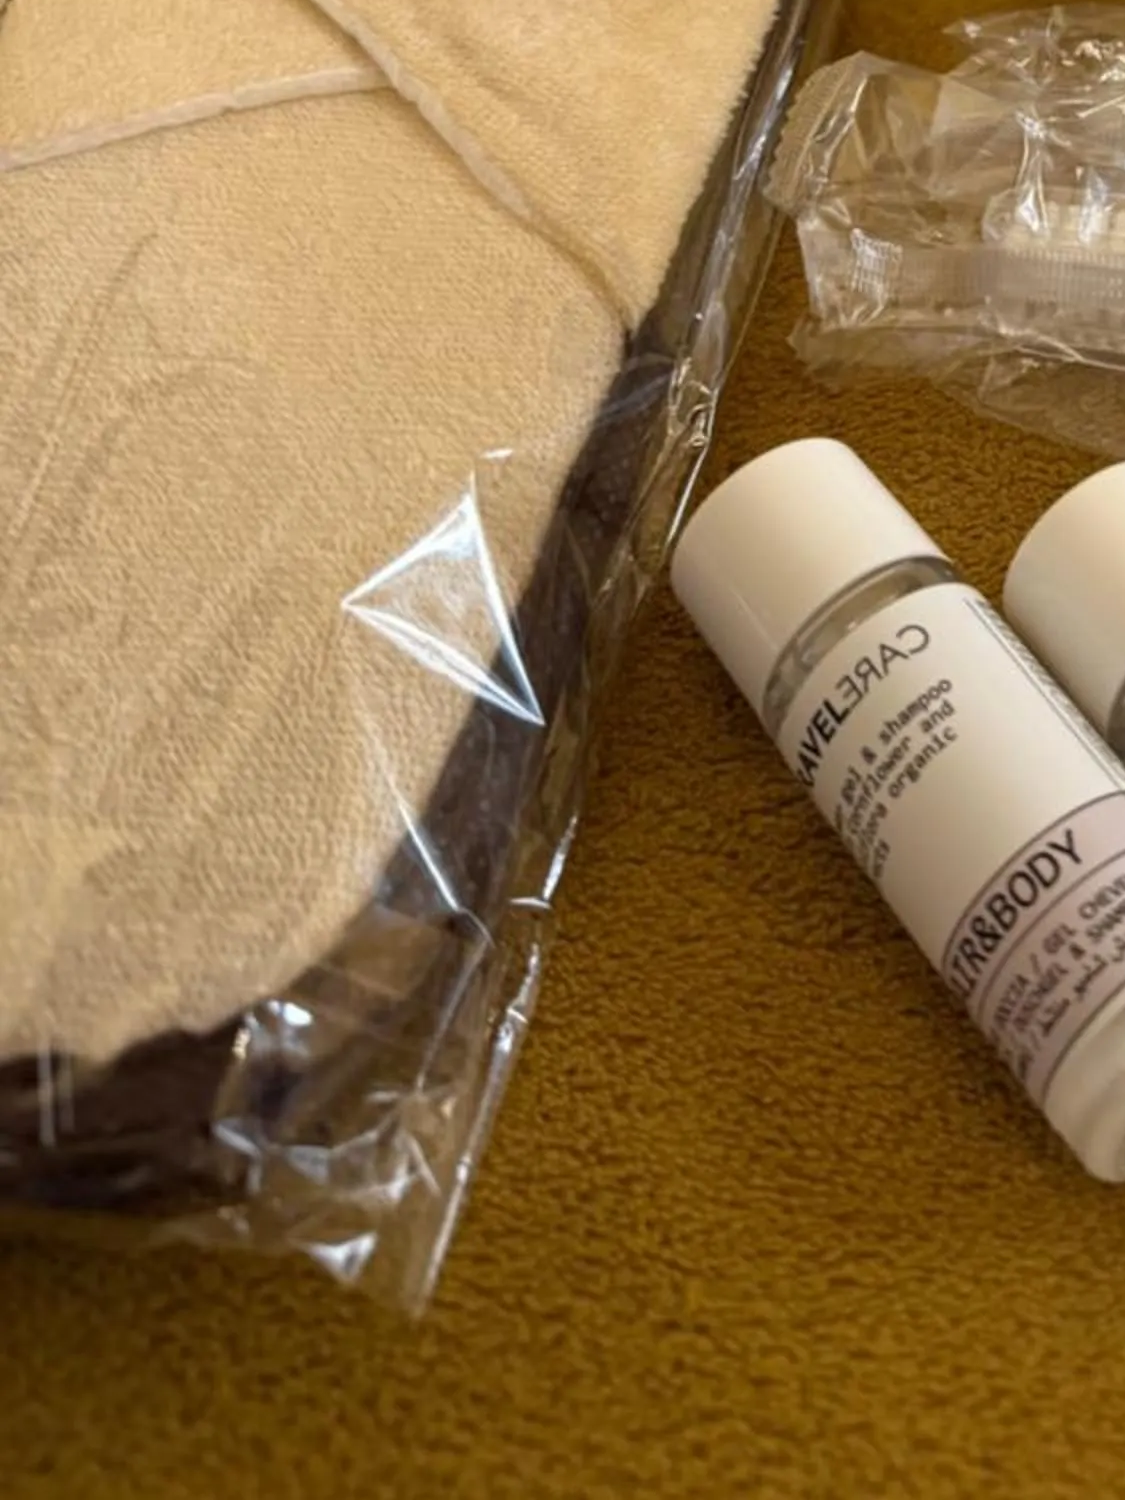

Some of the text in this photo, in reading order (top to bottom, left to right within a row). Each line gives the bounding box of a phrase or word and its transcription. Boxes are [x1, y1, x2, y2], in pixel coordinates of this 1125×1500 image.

[878, 678, 953, 747] shampoo
[918, 699, 956, 735] and
[888, 726, 958, 799] organic
[950, 828, 1082, 997] IR&BODY
